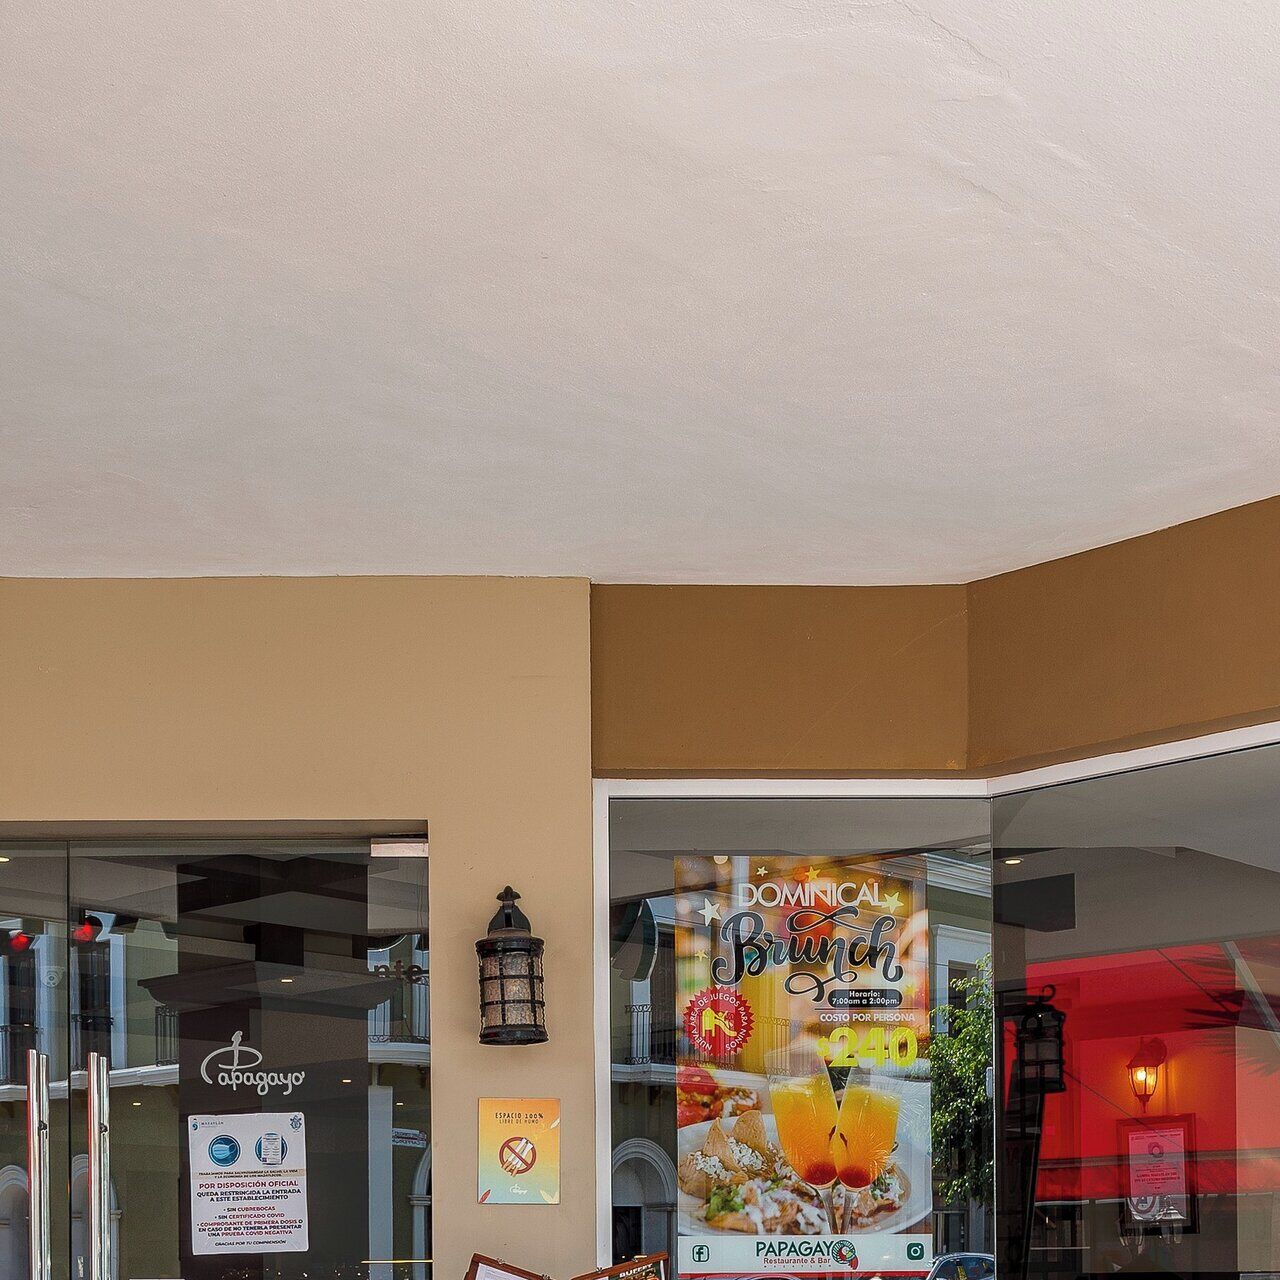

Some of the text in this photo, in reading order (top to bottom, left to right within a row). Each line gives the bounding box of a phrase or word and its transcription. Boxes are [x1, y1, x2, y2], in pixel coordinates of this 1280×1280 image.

[738, 882, 885, 908] DOMINICAL
[711, 906, 904, 1002] Brunch
[697, 996, 709, 1007] DE
[710, 993, 740, 1007] JUEGOS
[849, 990, 881, 998] Horario:
[869, 998, 900, 1006] 2:00pm.
[738, 1007, 748, 1027] PARA
[820, 1013, 916, 1022] COSTO POR PERSONA
[691, 1029, 712, 1051] NUEVA
[816, 1026, 918, 1068] $240
[201, 1030, 305, 1095] Papagayo
[217, 1180, 267, 1189] DISPOSICIÓN
